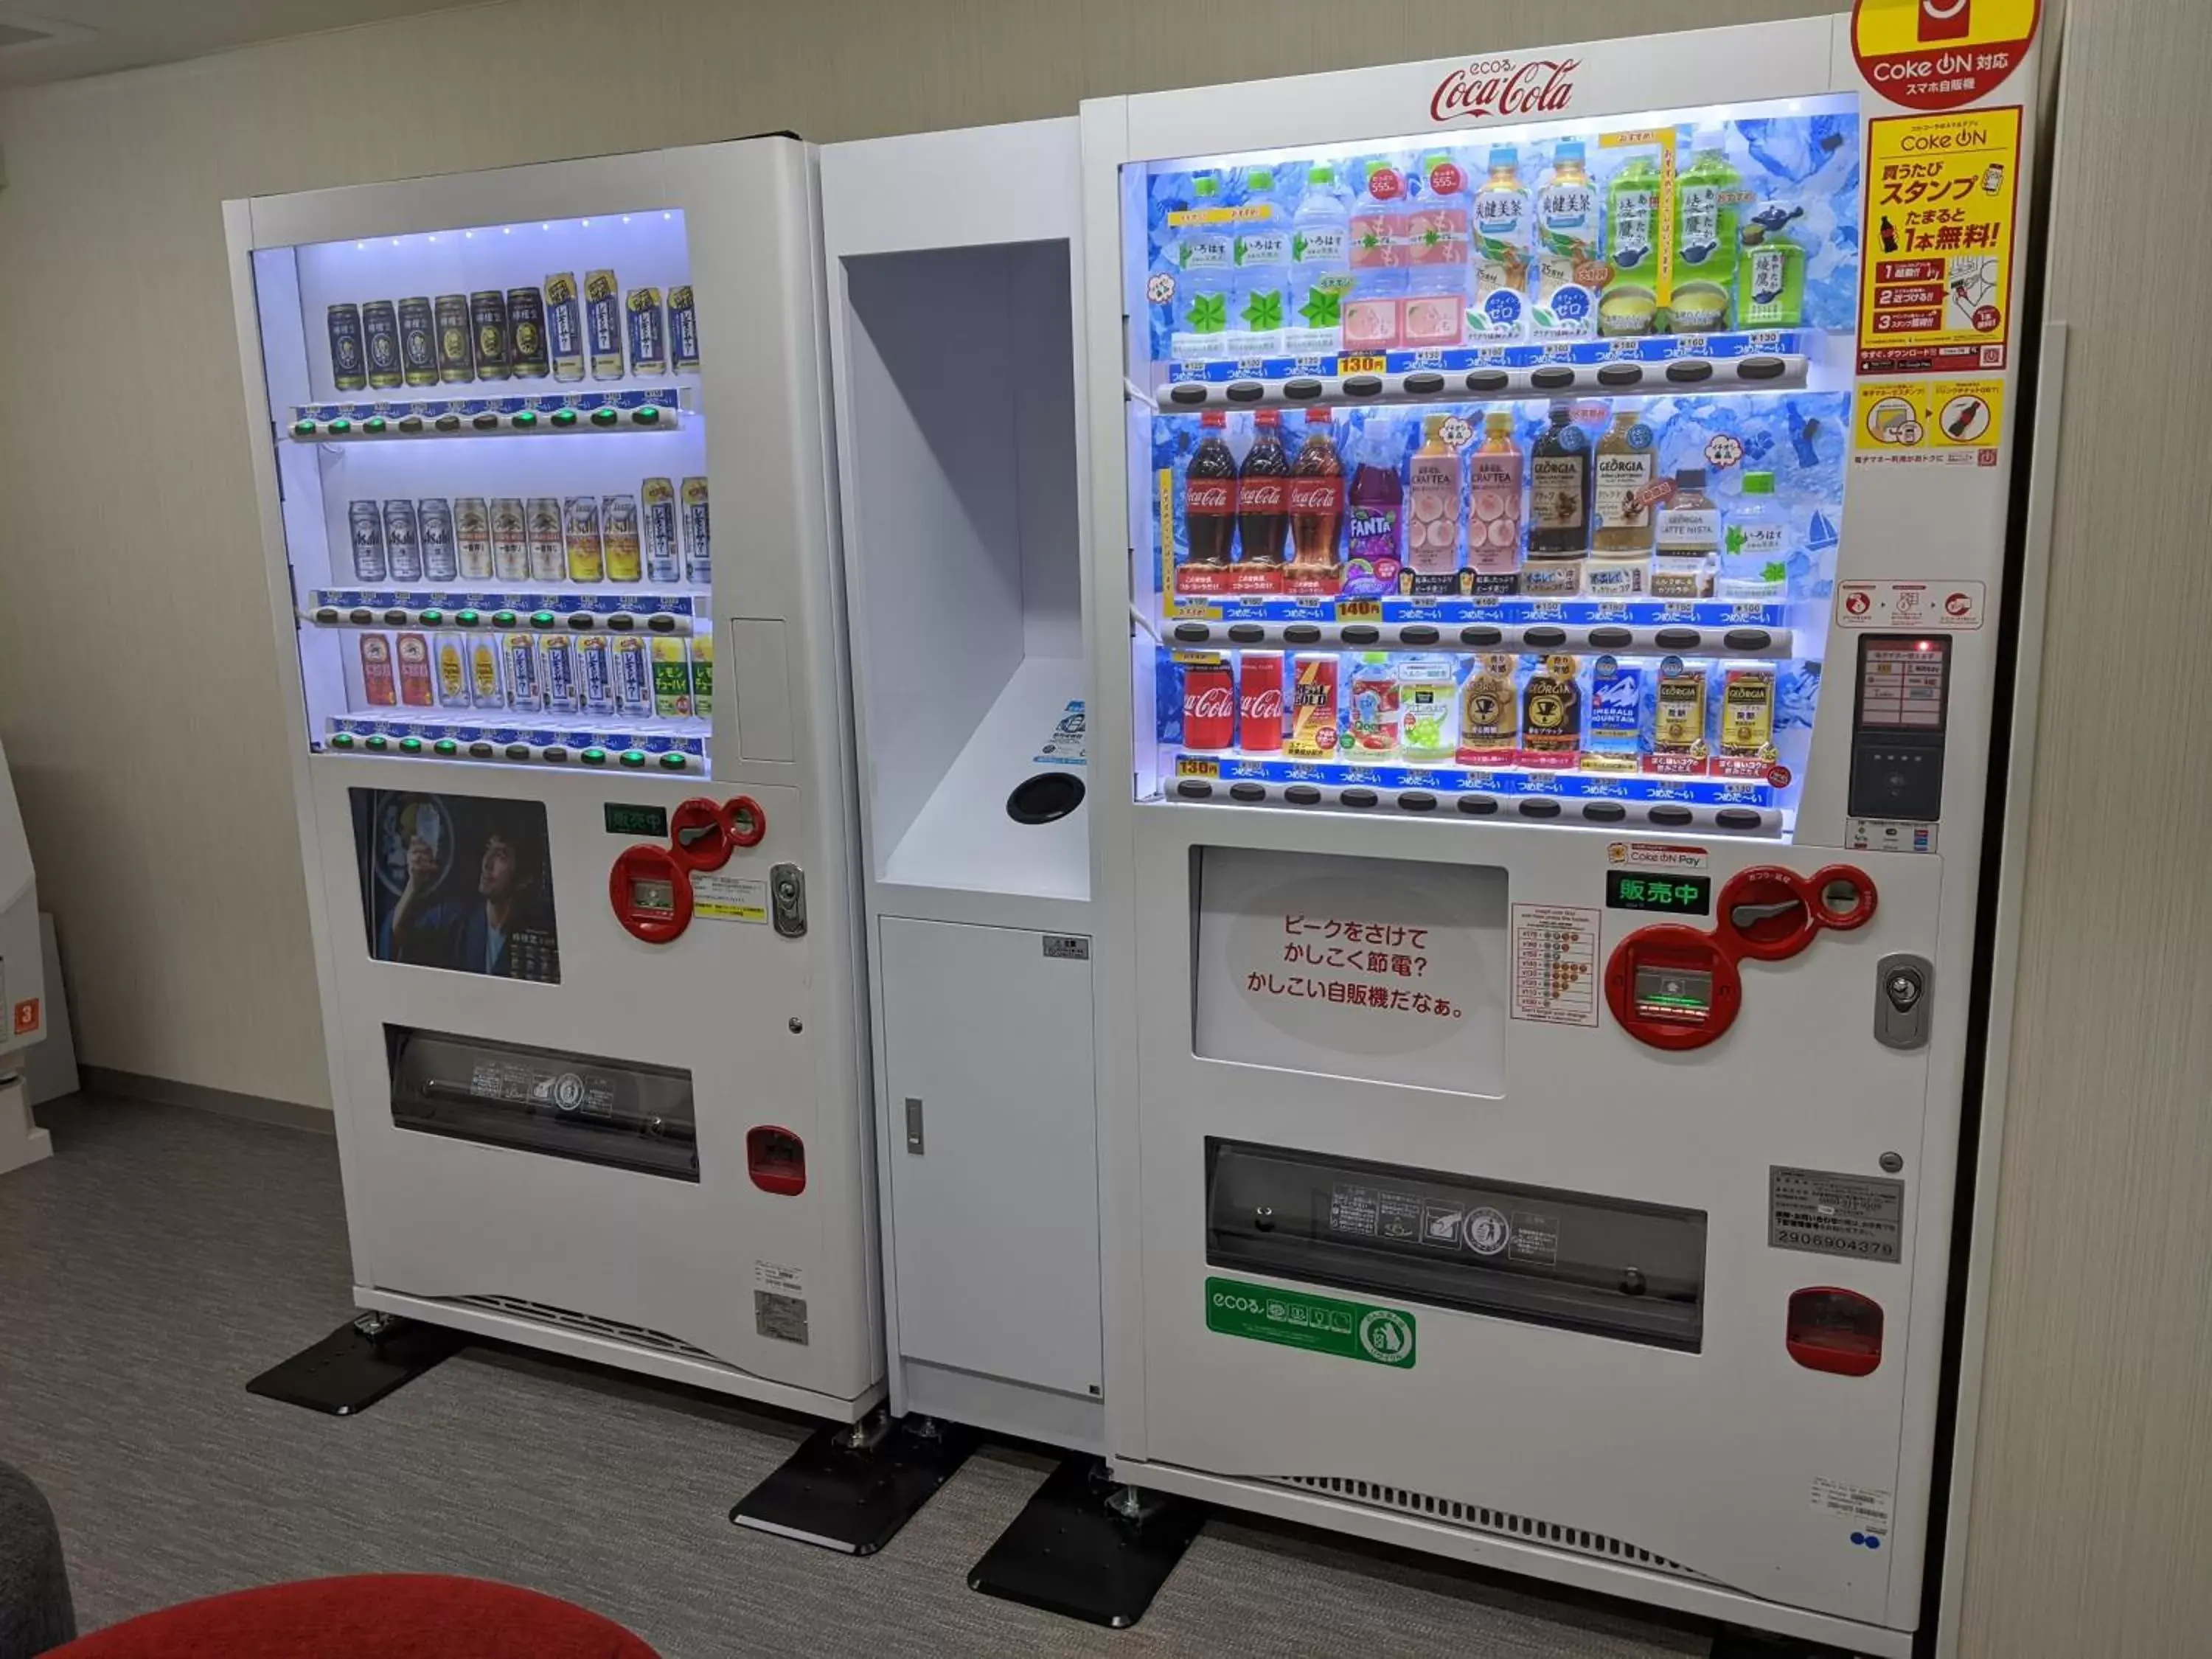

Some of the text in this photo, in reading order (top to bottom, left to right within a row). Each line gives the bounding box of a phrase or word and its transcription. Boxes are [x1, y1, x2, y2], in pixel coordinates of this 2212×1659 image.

[1874, 52, 2009, 81] Coke ON 対応
[1430, 58, 1584, 121] Coca-Cola
[1907, 77, 1976, 95] スマホ自販機
[1901, 128, 1987, 151] Coke ON
[1882, 161, 1944, 181] 買うたび
[1880, 174, 1980, 206] スタンプ
[1905, 208, 1966, 226] たまると
[1879, 290, 1891, 304] 2
[1878, 315, 1891, 329] 3
[1340, 356, 1383, 373] 130円
[1534, 461, 1577, 474] GEORGIA
[1599, 458, 1644, 473] GEORGIA
[1351, 518, 1391, 538] FANTA
[1341, 602, 1379, 616] 140円
[1180, 761, 1217, 774] 130円
[1630, 851, 1658, 863] Coke
[1680, 855, 1700, 867] Pay
[1619, 879, 1699, 905] 販売中
[1285, 911, 1428, 949] ピークをさけて
[1284, 942, 1427, 978] かしこく節電?
[21, 1005, 32, 1023] 3
